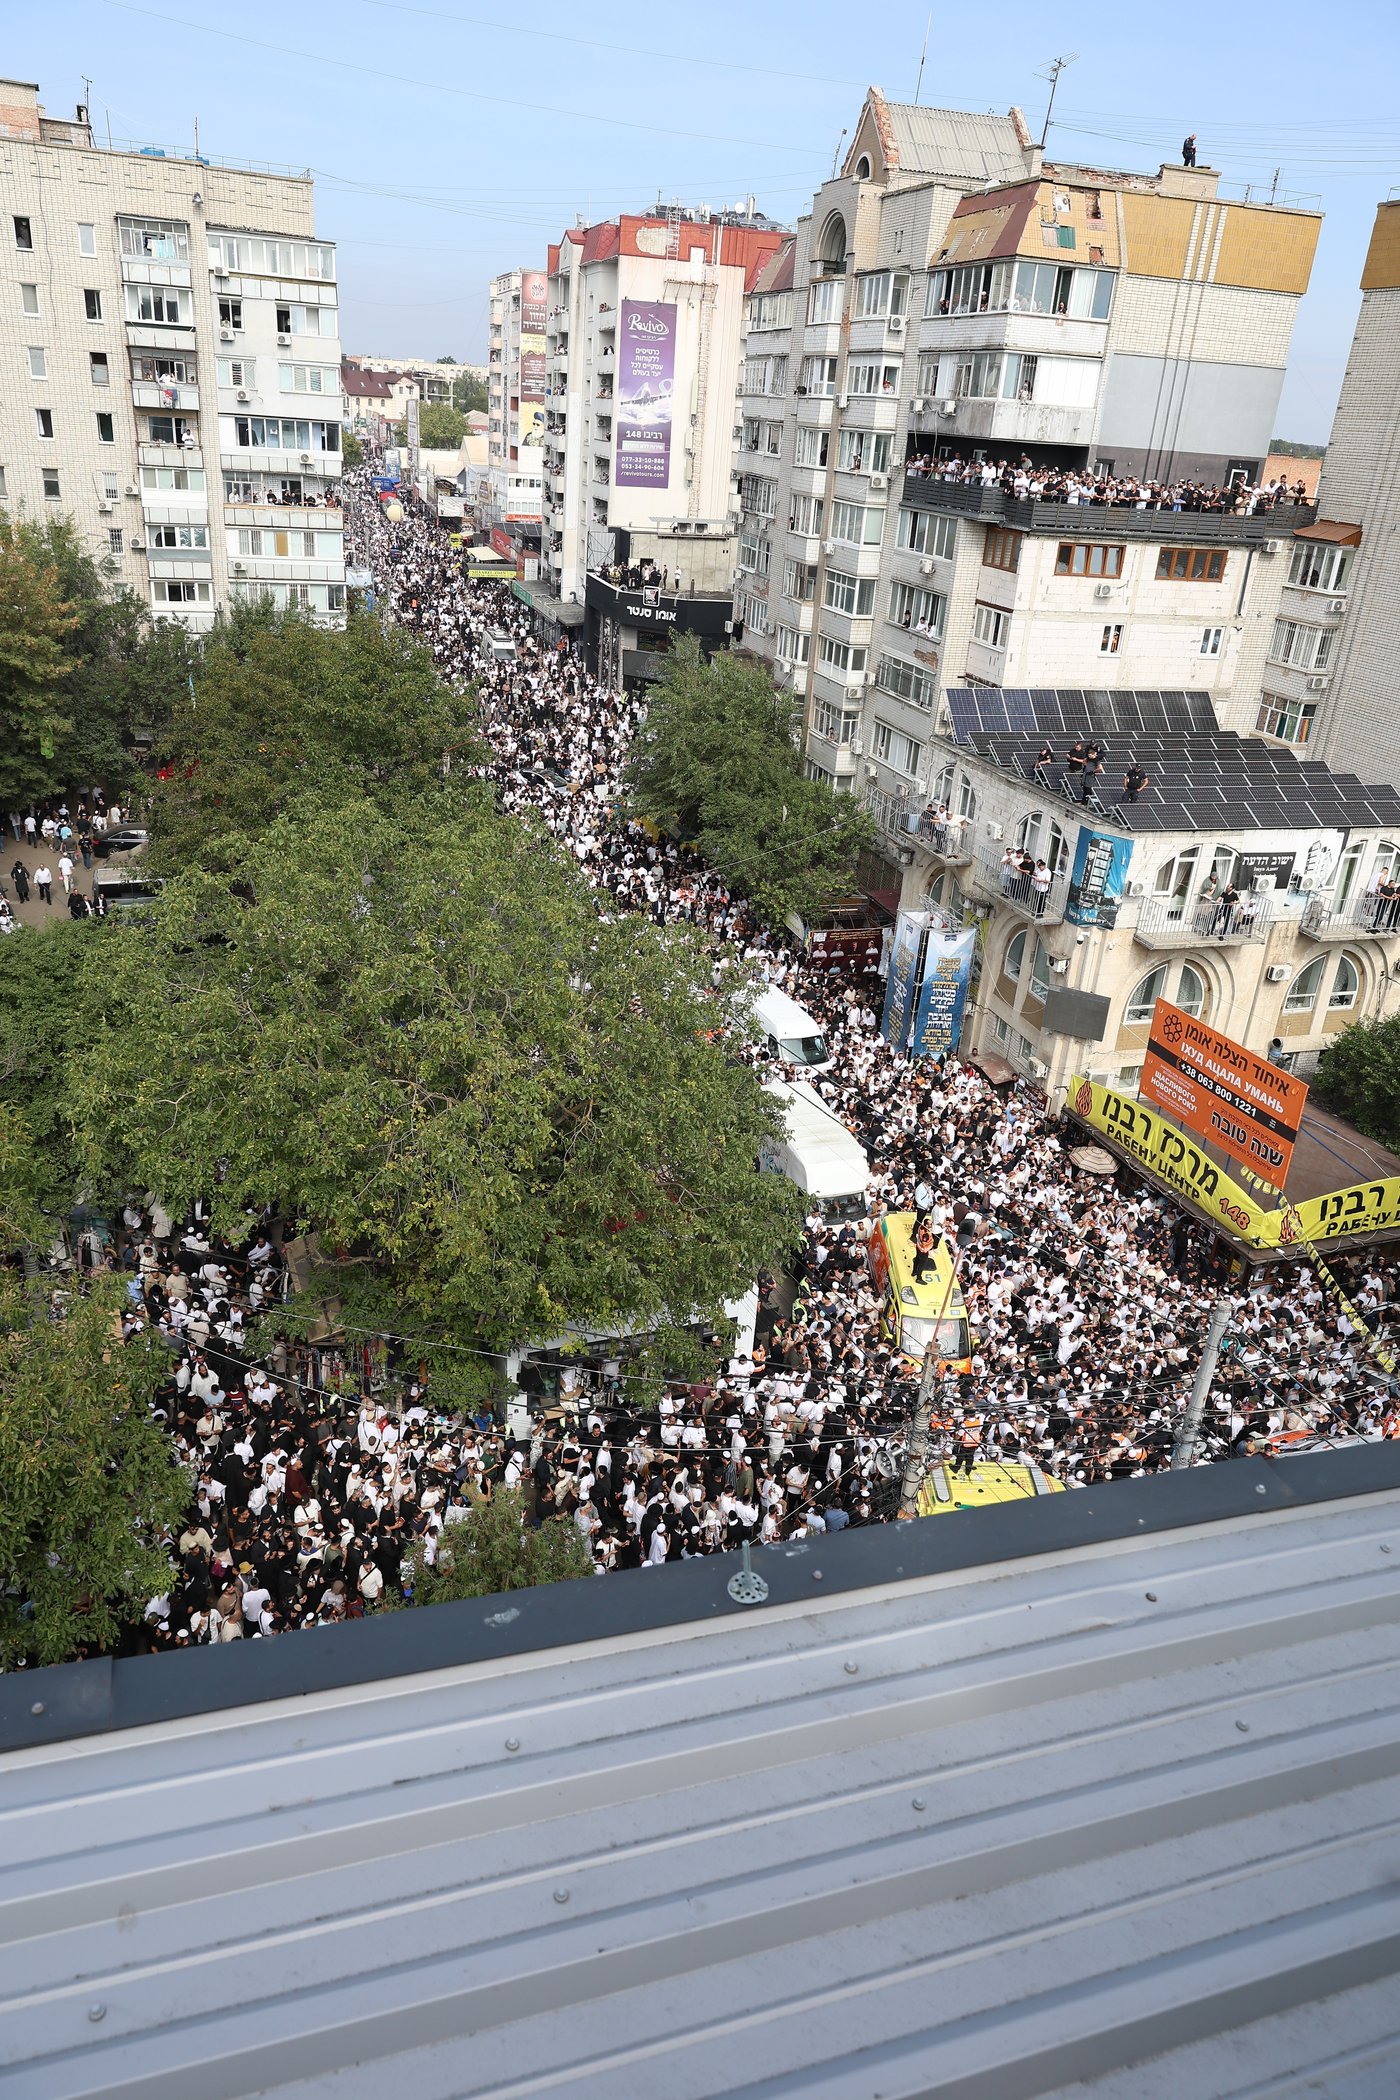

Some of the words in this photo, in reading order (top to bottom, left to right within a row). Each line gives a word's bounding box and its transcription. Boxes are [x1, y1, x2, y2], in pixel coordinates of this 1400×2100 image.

[627, 313, 666, 333] Revivo
[630, 361, 641, 369] לכל
[635, 347, 660, 355] כרטיסים
[635, 354, 660, 362] ללקוחות
[632, 369, 650, 377] בעולם
[642, 362, 664, 371] עסקיים
[625, 430, 642, 439] 148
[643, 431, 663, 440] רביבו
[627, 605, 652, 618] סנטר
[655, 609, 677, 622] אומן
[1241, 856, 1269, 866] הדעת
[1271, 856, 1294, 866] ישוב
[1185, 1023, 1212, 1049] אומן
[1214, 1040, 1248, 1072] הצלה
[1154, 1070, 1196, 1102] ЩАСЛИВОГО
[1180, 1063, 1196, 1079] +38
[1198, 1073, 1214, 1091] 063
[1215, 1084, 1232, 1102] 800
[1234, 1096, 1257, 1118] 1221
[1181, 1042, 1204, 1066] ІХУД
[1205, 1058, 1242, 1087] АЦАЛА
[1244, 1081, 1284, 1114] УМАНЬ
[1252, 1063, 1291, 1097] איחוד
[1150, 1077, 1177, 1100] НОВОГО
[1177, 1094, 1197, 1114] РОКУ!
[1101, 1093, 1152, 1141] רבנו
[1211, 1109, 1247, 1145] טובה
[1106, 1123, 1158, 1163] РАБЕНУ
[1158, 1159, 1200, 1200] ЦЕНТР
[1159, 1127, 1219, 1197] מרכז
[1250, 1136, 1285, 1168] שנה
[1219, 1197, 1251, 1230] 148
[1319, 1186, 1385, 1221] רבנו
